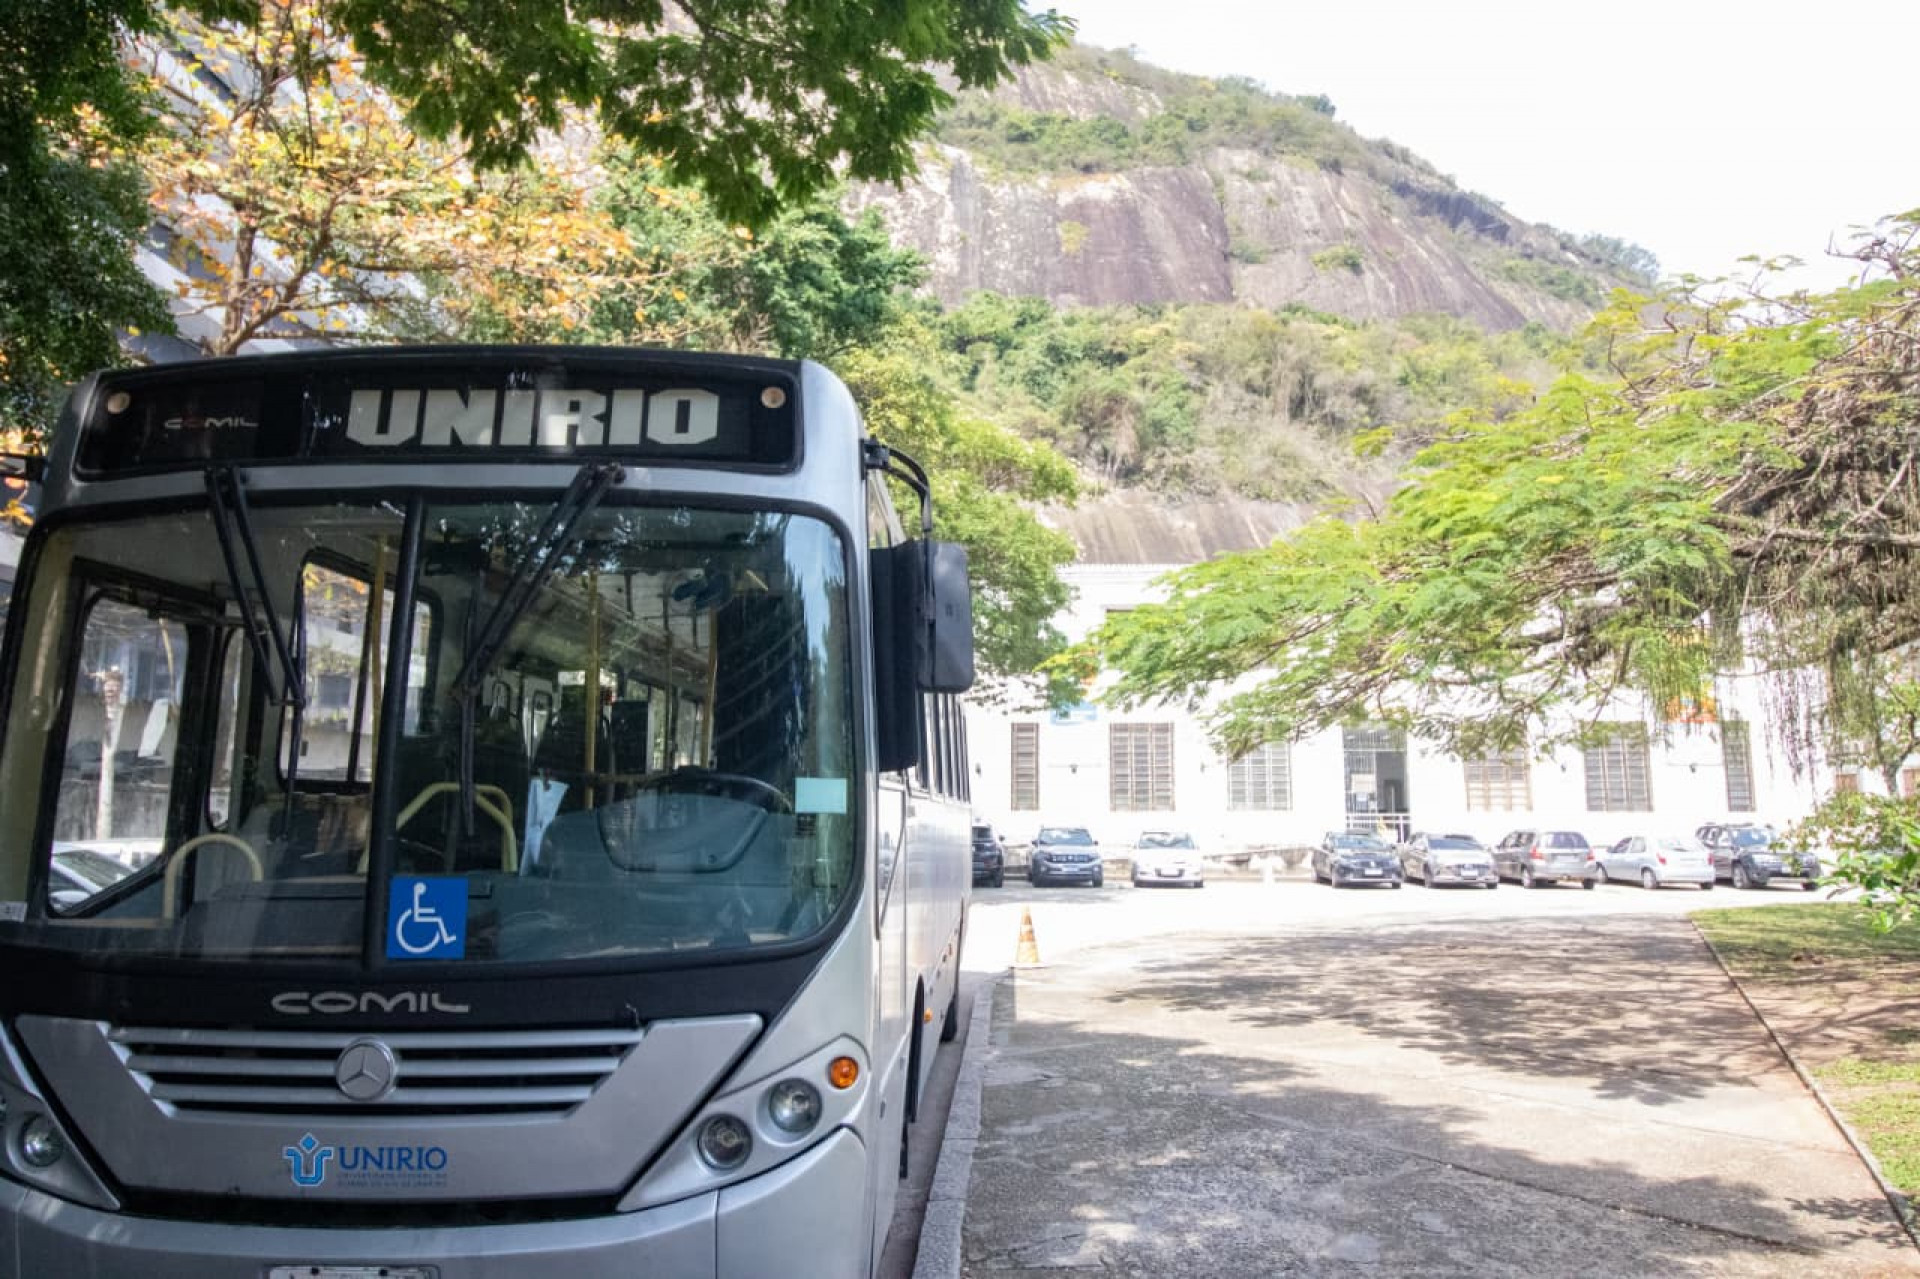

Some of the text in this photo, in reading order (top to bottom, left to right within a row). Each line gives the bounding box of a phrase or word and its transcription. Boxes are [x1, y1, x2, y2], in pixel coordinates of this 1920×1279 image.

[164, 416, 259, 429] COMIL
[346, 389, 720, 446] UNIRIO
[271, 991, 469, 1014] COMIL
[338, 1146, 448, 1171] UNIRIO
